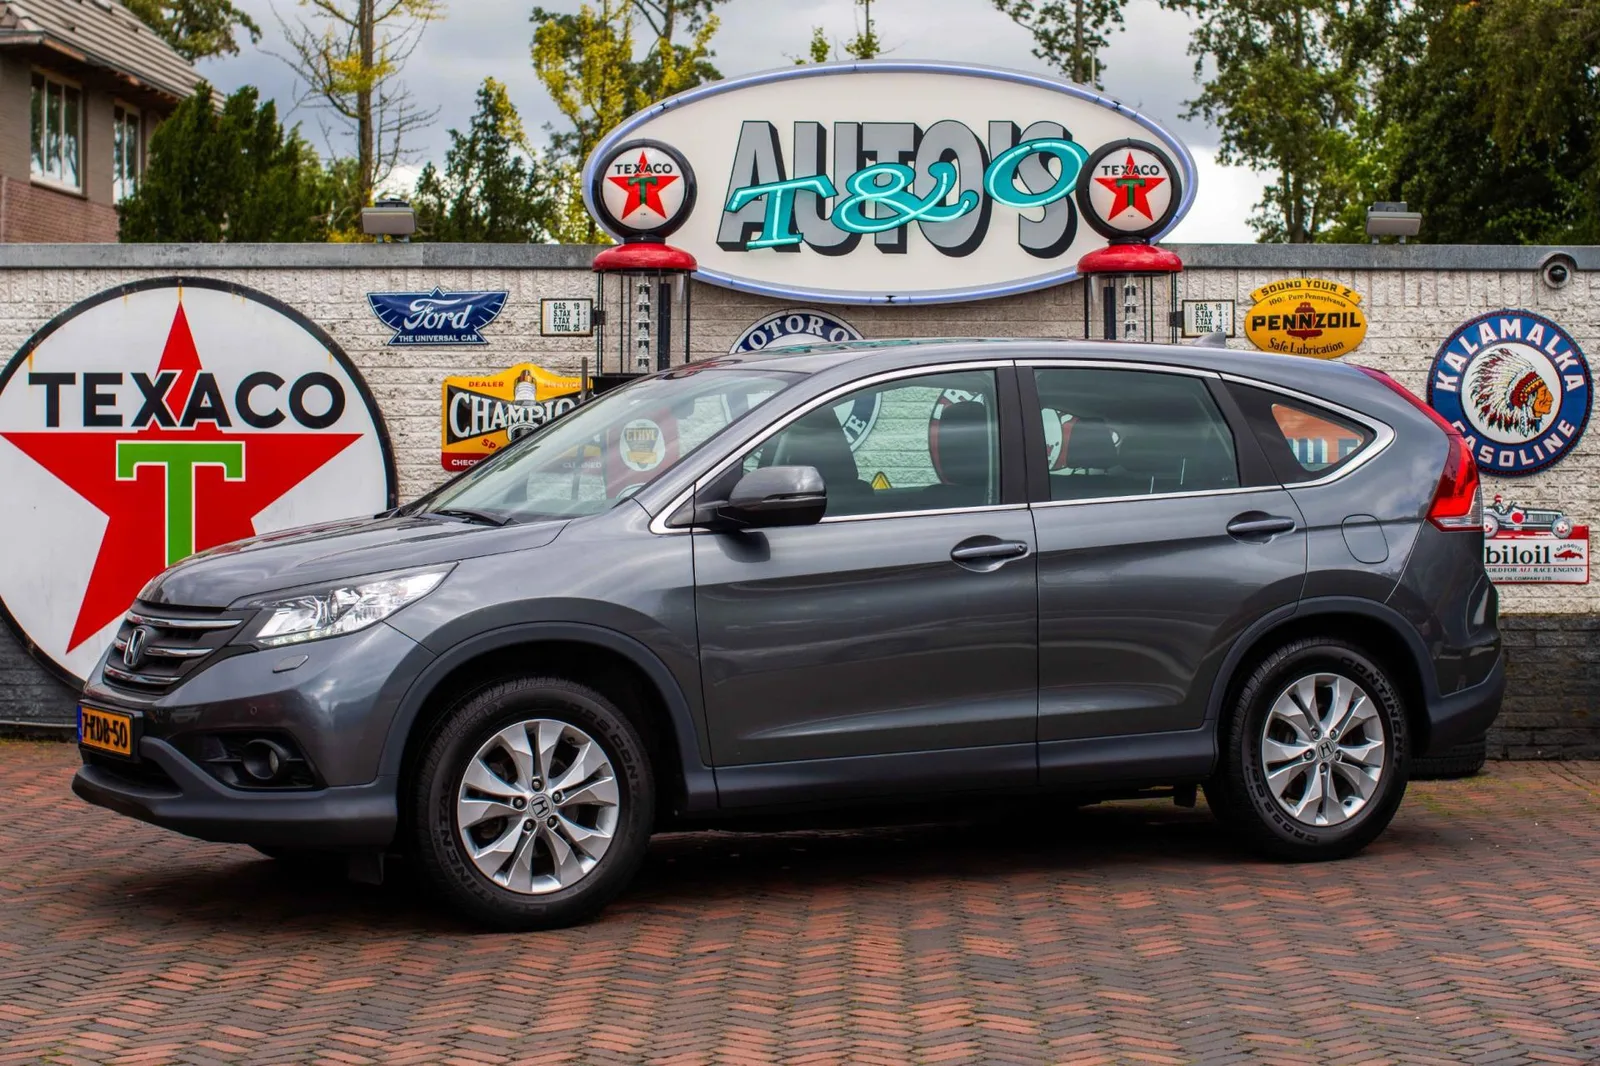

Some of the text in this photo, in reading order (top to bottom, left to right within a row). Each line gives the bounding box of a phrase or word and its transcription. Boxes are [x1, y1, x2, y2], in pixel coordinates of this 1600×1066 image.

[615, 163, 673, 175] TEXACO
[1102, 164, 1160, 176] TEXACO
[716, 119, 1078, 259] AUTO'S
[1261, 279, 1353, 298] SOUND YOUR Z
[553, 302, 566, 310] GAS
[573, 302, 580, 310] 19
[1305, 293, 1346, 308] Pennsylvania
[403, 298, 472, 330] Ford
[553, 309, 571, 317] S.TAX
[553, 317, 570, 325] F.TAX
[1195, 310, 1213, 318] S.TAX
[1195, 325, 1214, 333] TOTAL
[1252, 312, 1361, 331] PENNZOIL
[399, 333, 478, 343] THE UNIVERSAL CAR
[738, 315, 824, 351] OTOR
[1268, 337, 1345, 355] Safe Lubrication
[1435, 318, 1585, 393] KALAMALKA
[28, 371, 346, 429] TEXACO
[449, 391, 582, 438] CHAMPIO
